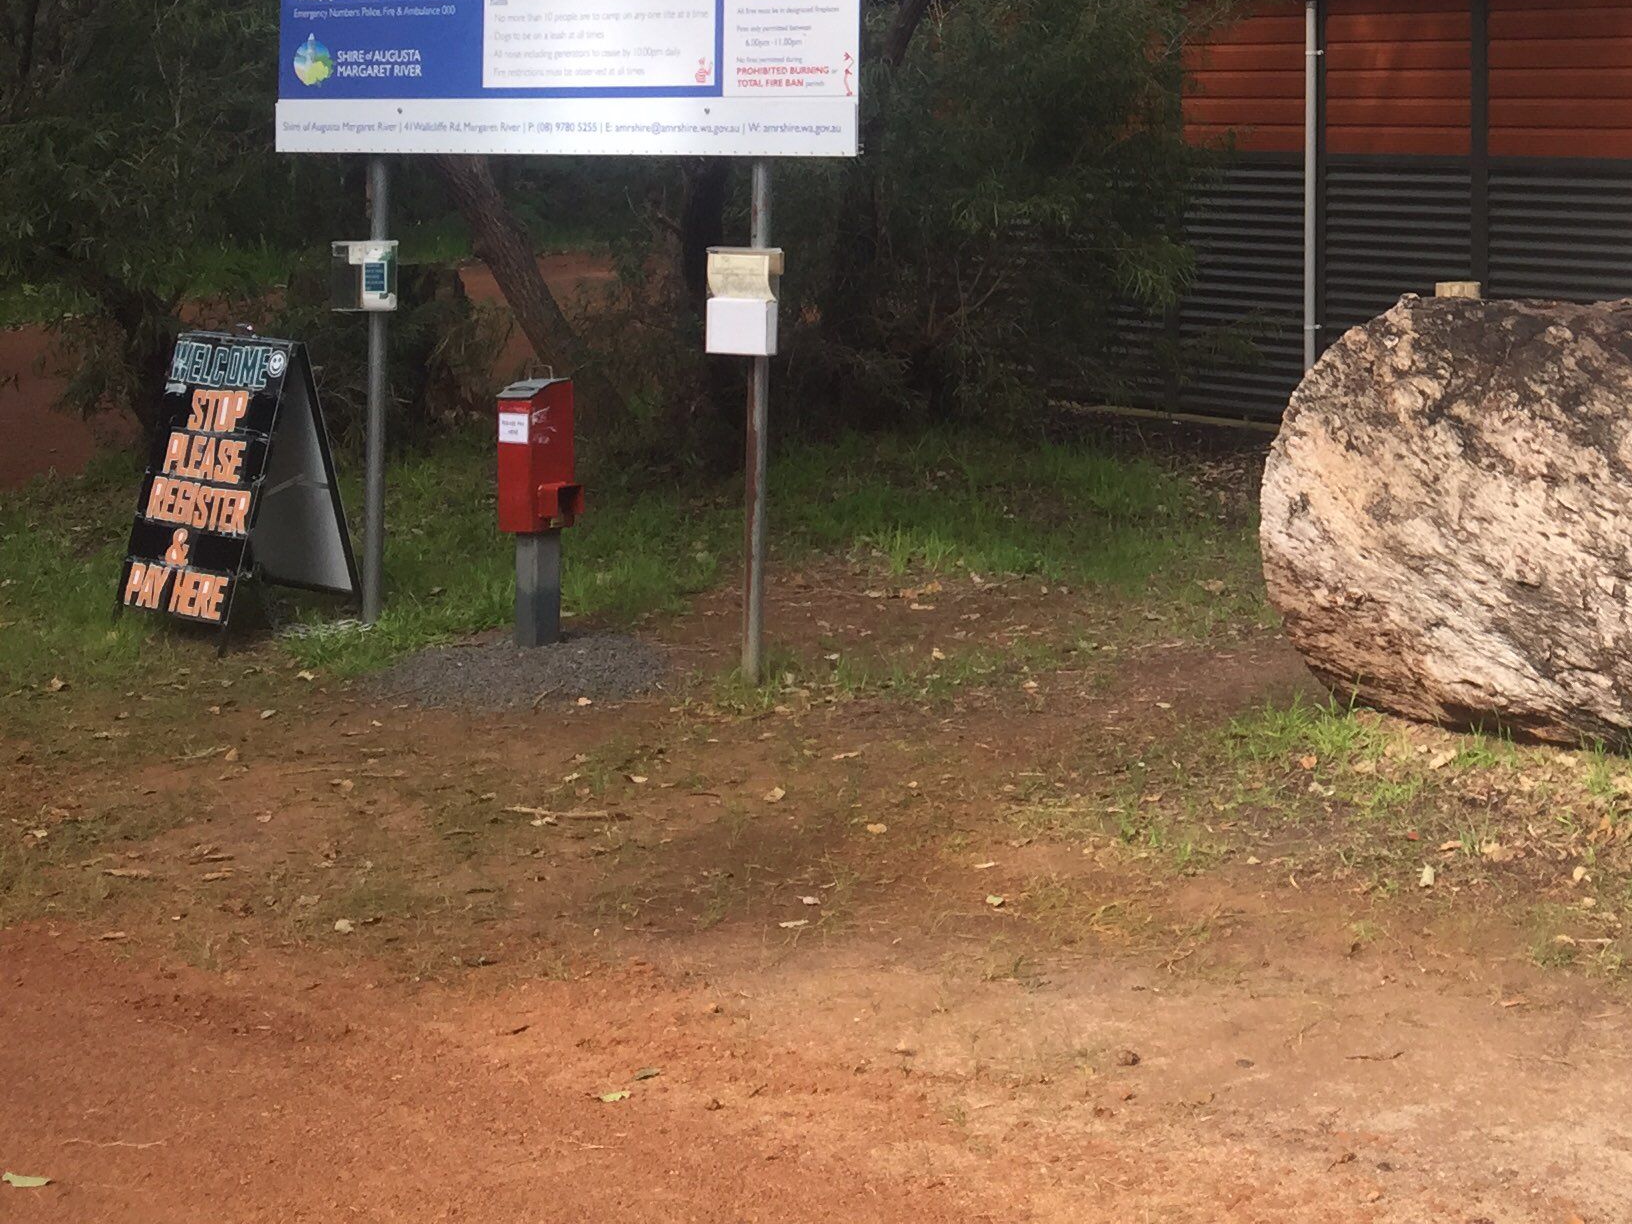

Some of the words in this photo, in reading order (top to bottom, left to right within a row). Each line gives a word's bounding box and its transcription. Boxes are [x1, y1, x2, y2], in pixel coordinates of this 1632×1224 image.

[293, 8, 328, 20] Emergency
[336, 64, 391, 77] MARGARET
[393, 64, 422, 77] RIVER
[337, 50, 364, 63] SHIRE
[373, 49, 422, 62] AUGUSTA
[736, 66, 788, 76] PROHIBITED
[789, 66, 829, 75] BURNING
[737, 79, 763, 88] TOTAL
[765, 78, 783, 87] FIRE
[785, 78, 804, 87] BAN
[555, 121, 575, 132] 9780
[170, 340, 274, 388] WELCOME
[187, 389, 249, 432] STOP
[163, 432, 247, 484] PLEASE
[146, 476, 251, 533] REGISTER
[165, 528, 189, 566] &
[124, 563, 171, 610] PAY
[168, 567, 228, 620] HERE
